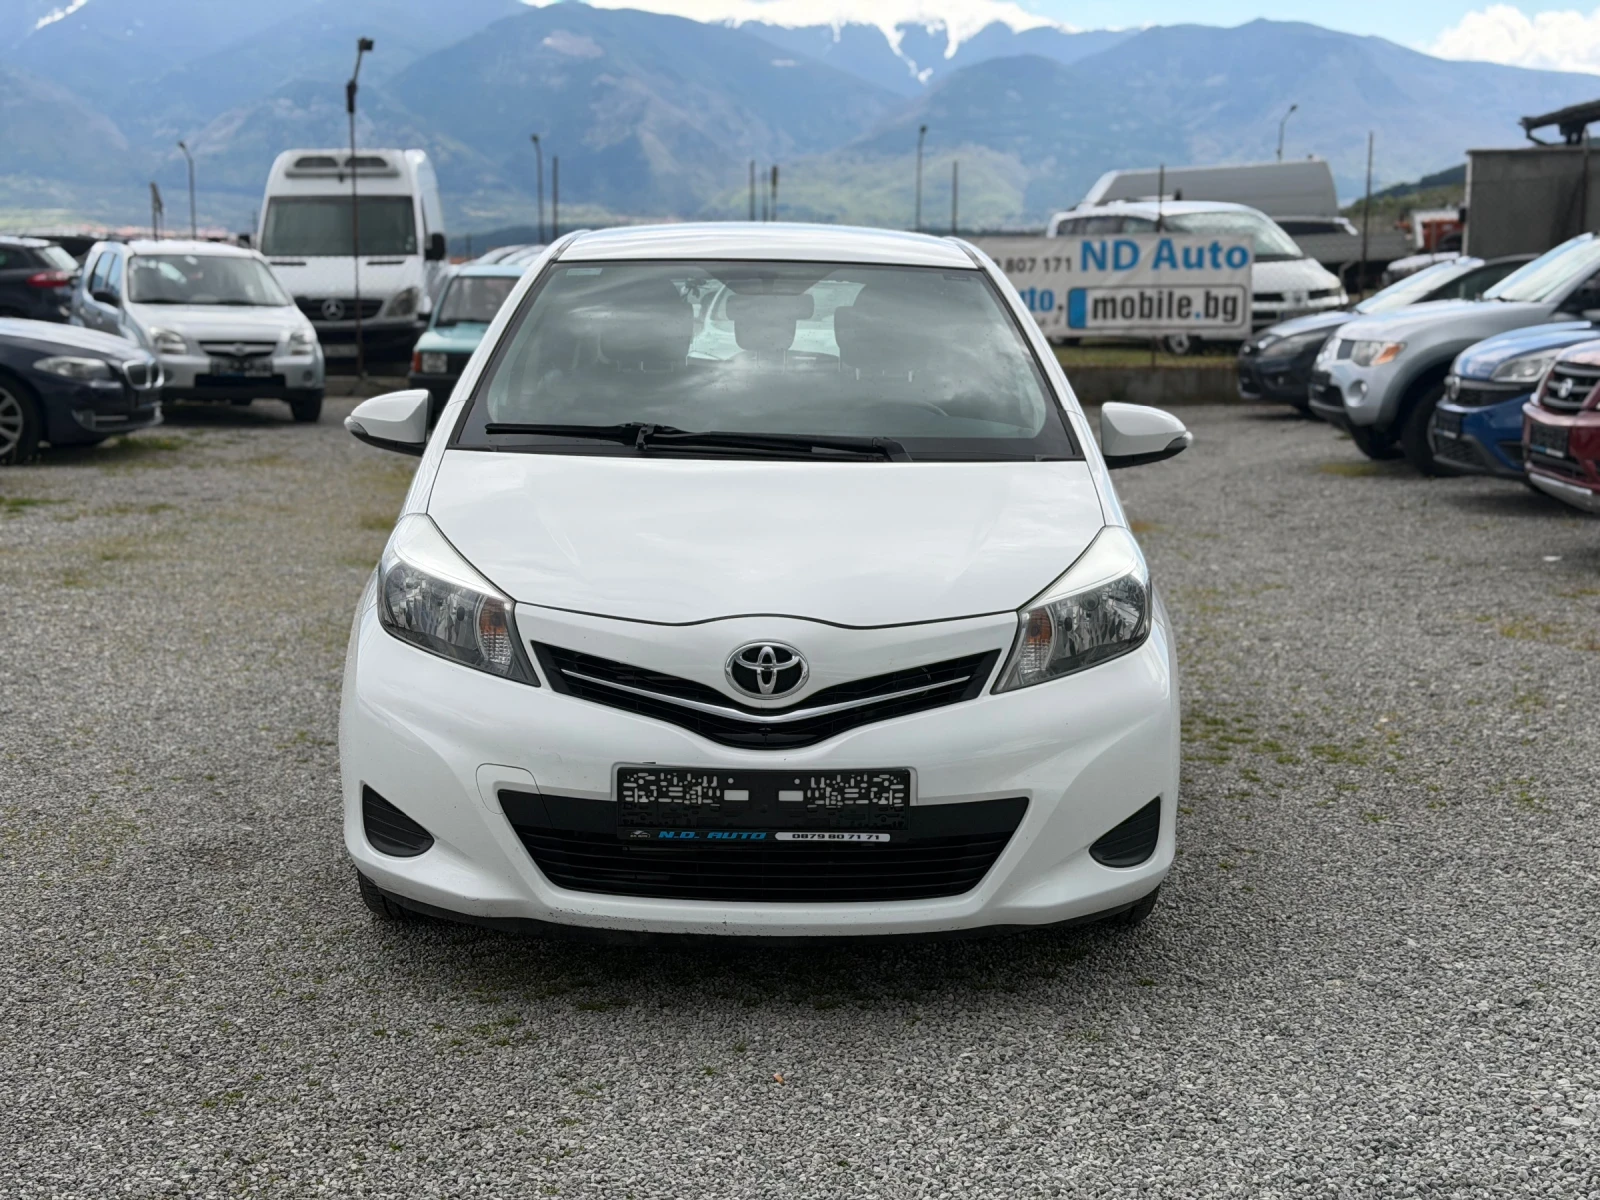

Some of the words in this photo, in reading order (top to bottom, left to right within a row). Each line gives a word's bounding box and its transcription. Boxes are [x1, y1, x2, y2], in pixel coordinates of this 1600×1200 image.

[1043, 256, 1072, 273] 171
[1081, 239, 1140, 272] ND
[1152, 237, 1249, 270] Auto
[1092, 290, 1239, 323] mobile.bg
[658, 830, 700, 839] N.D.
[706, 832, 767, 840] AUTO
